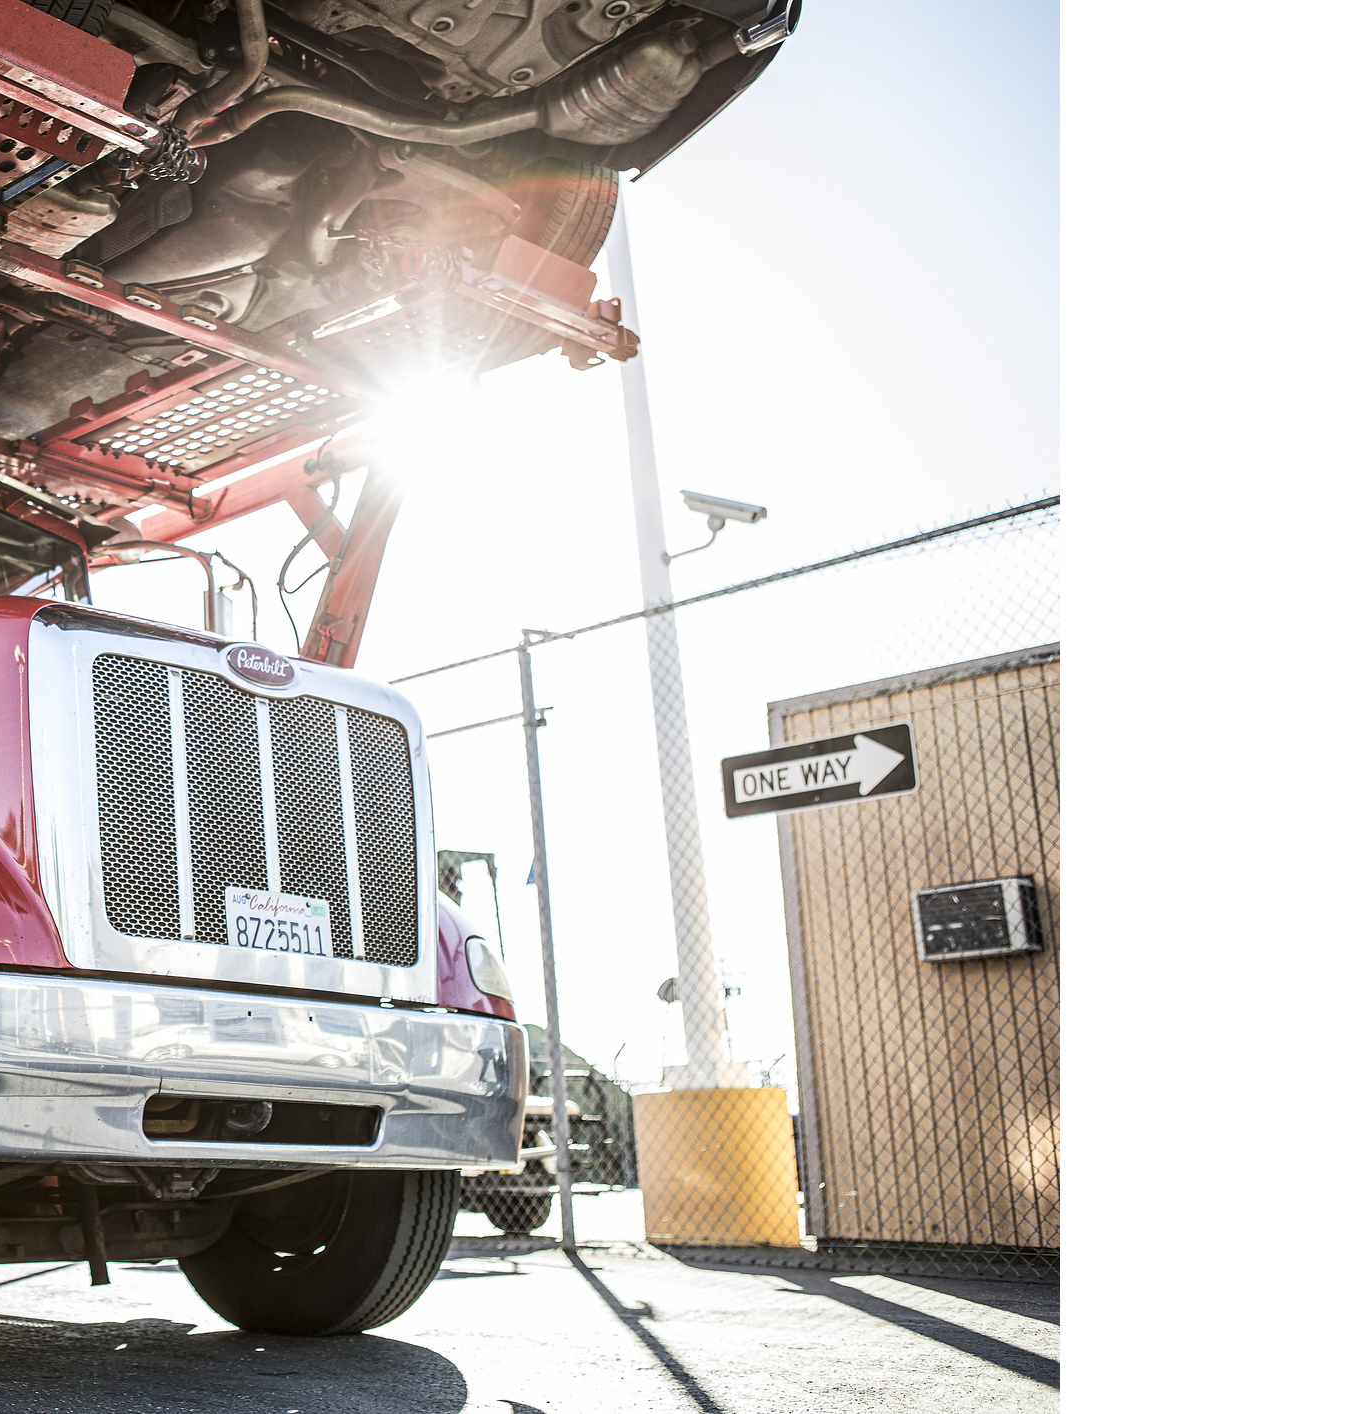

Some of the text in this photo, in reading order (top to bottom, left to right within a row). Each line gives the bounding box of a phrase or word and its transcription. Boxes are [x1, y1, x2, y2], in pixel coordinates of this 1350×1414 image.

[237, 648, 290, 678] Peterbilt
[743, 756, 851, 796] ONE WAY
[232, 894, 312, 918] AUG California
[236, 915, 327, 957] 8Z25511
